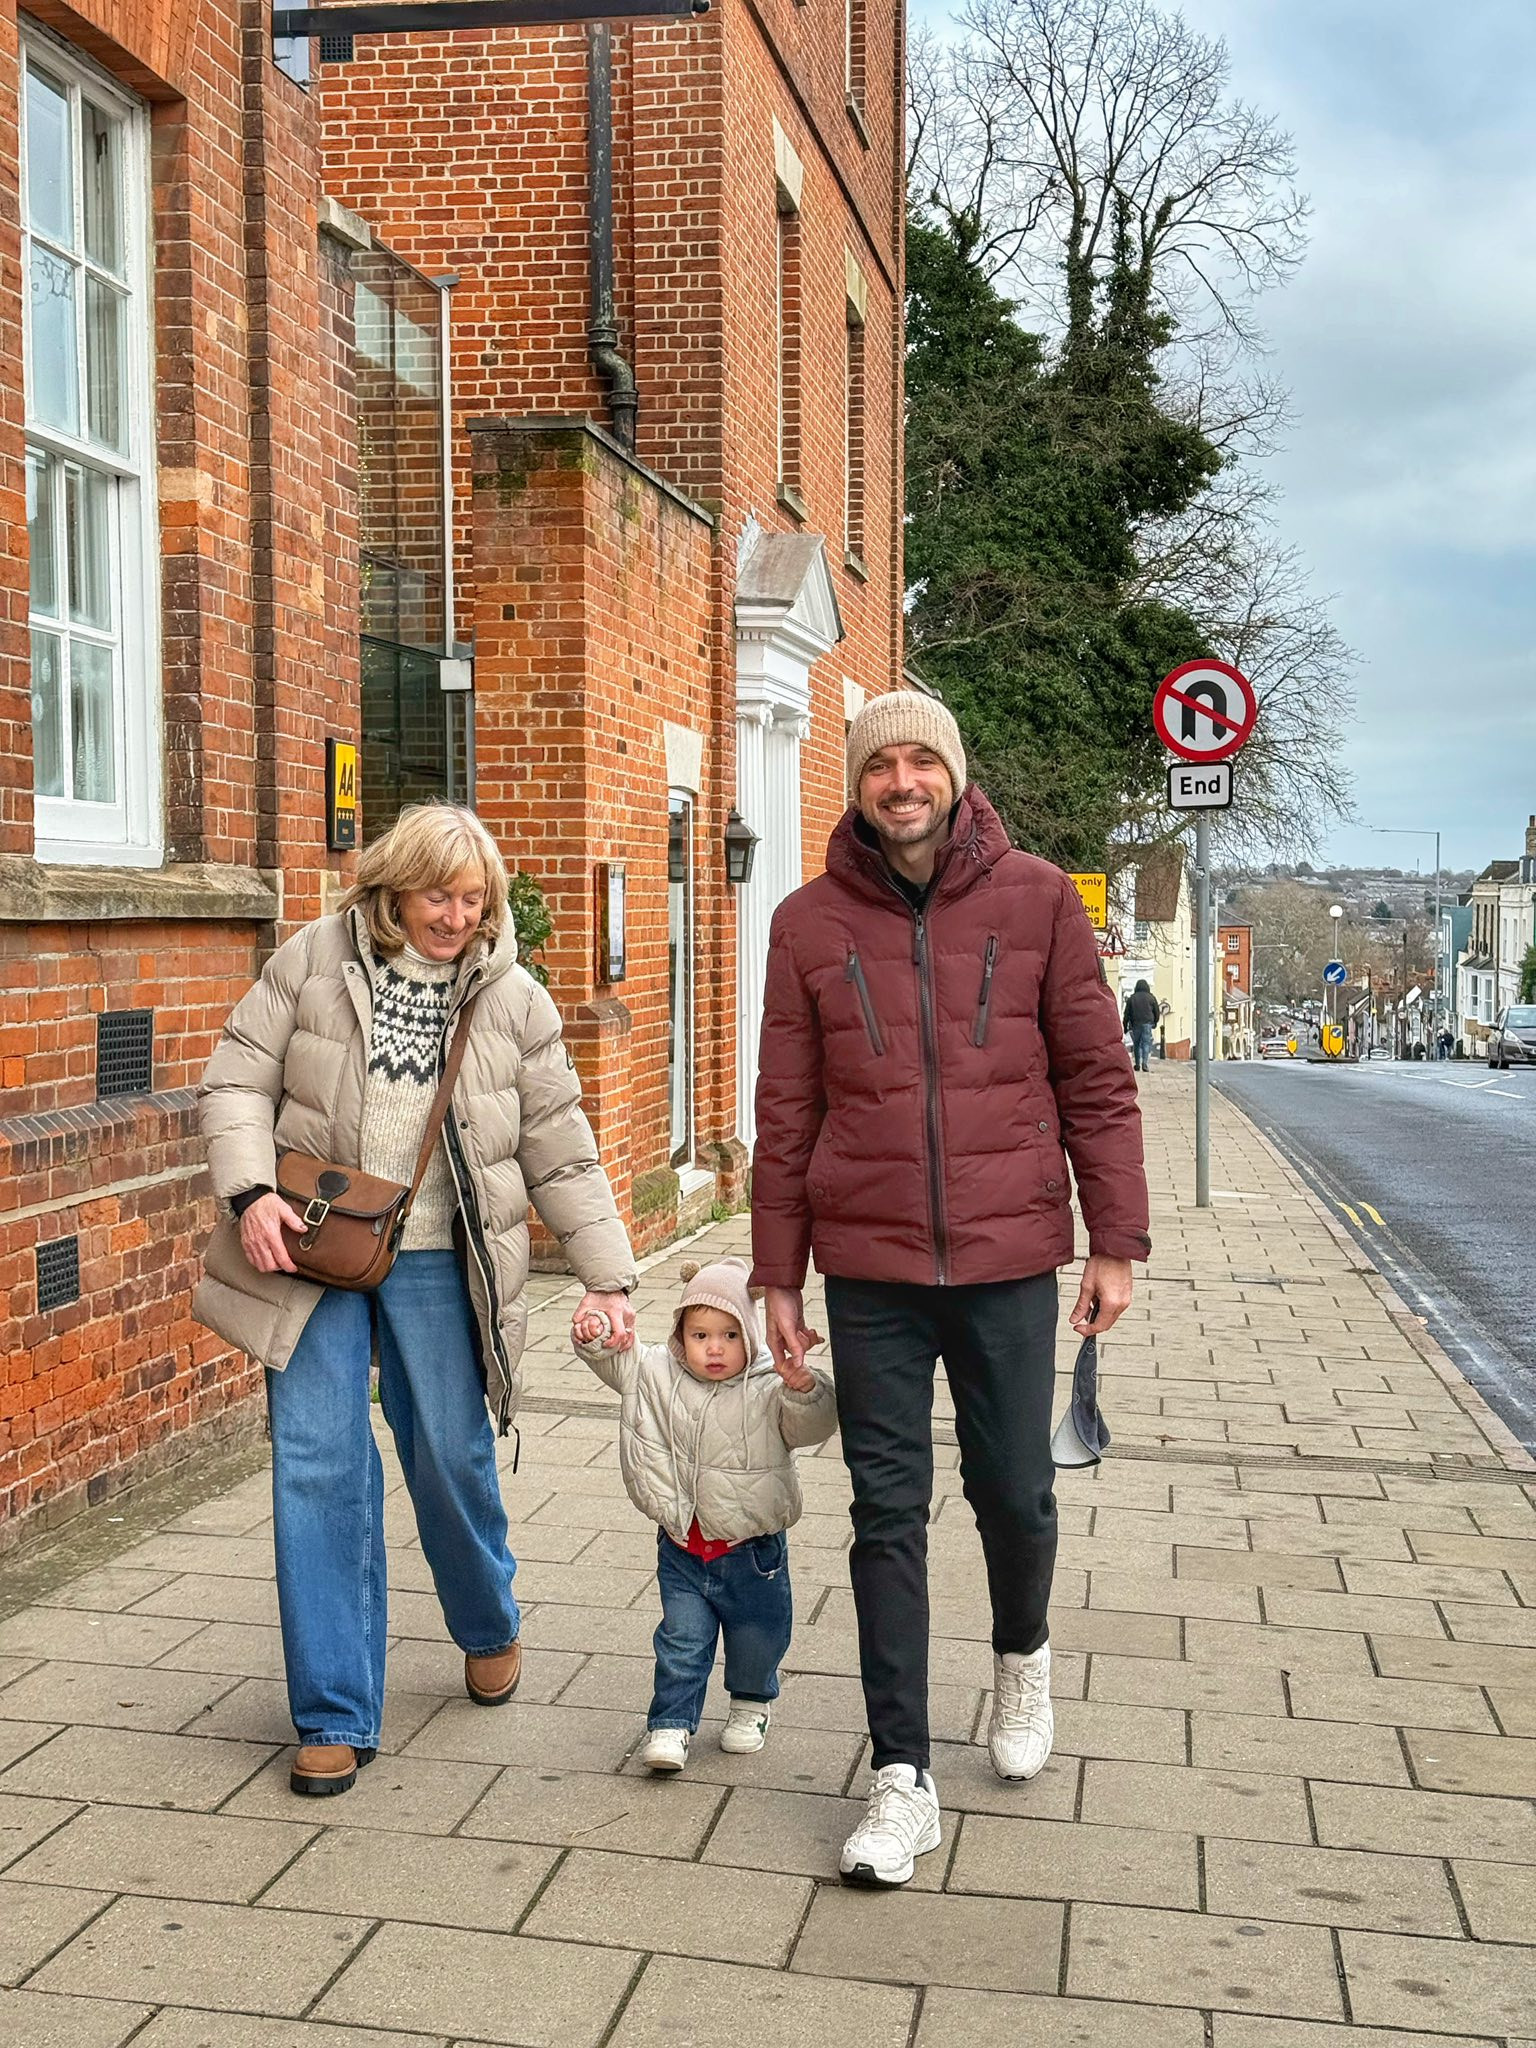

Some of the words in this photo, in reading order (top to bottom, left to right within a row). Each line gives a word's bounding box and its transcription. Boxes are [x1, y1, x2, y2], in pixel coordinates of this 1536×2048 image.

[339, 762, 353, 797] AA
[1180, 775, 1220, 795] End
[1081, 877, 1103, 887] only
